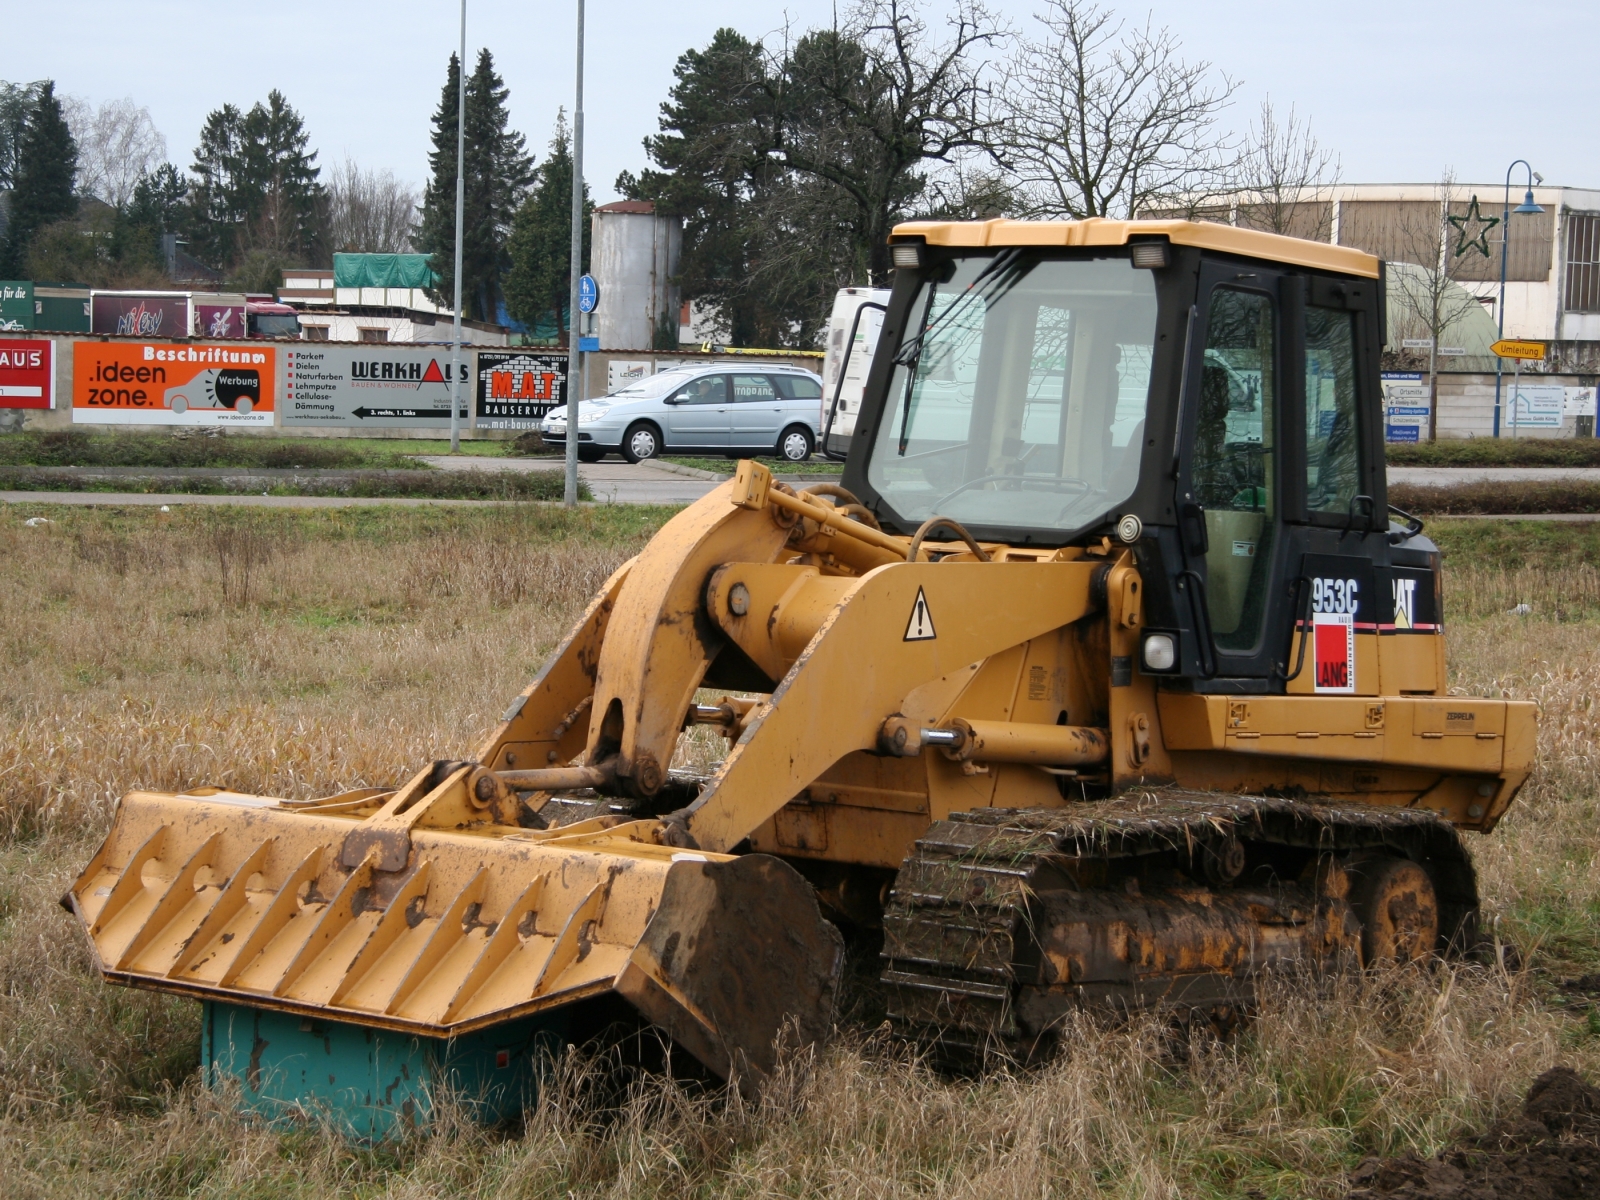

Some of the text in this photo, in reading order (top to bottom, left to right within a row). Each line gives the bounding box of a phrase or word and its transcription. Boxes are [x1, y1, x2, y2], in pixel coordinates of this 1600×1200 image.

[15, 286, 26, 299] die
[296, 352, 324, 360] Parkett
[1501, 345, 1539, 357] Umleitung
[296, 362, 320, 370] Dielen
[218, 375, 258, 389] Werbung
[296, 373, 343, 381] Naturfarben
[295, 382, 337, 392] Lehmputze
[491, 371, 556, 400] M.A.T
[88, 388, 154, 406] zone.
[295, 392, 332, 400] Cellulose-
[1400, 388, 1423, 396] Ortsmitte
[295, 402, 335, 412] Dämmung
[485, 405, 553, 416] BAUSERVIC
[217, 414, 265, 422] www.ideenzone.de
[1312, 577, 1358, 614] 953C
[1316, 661, 1349, 687] LANG
[1447, 712, 1475, 720] ZEPPELIN
